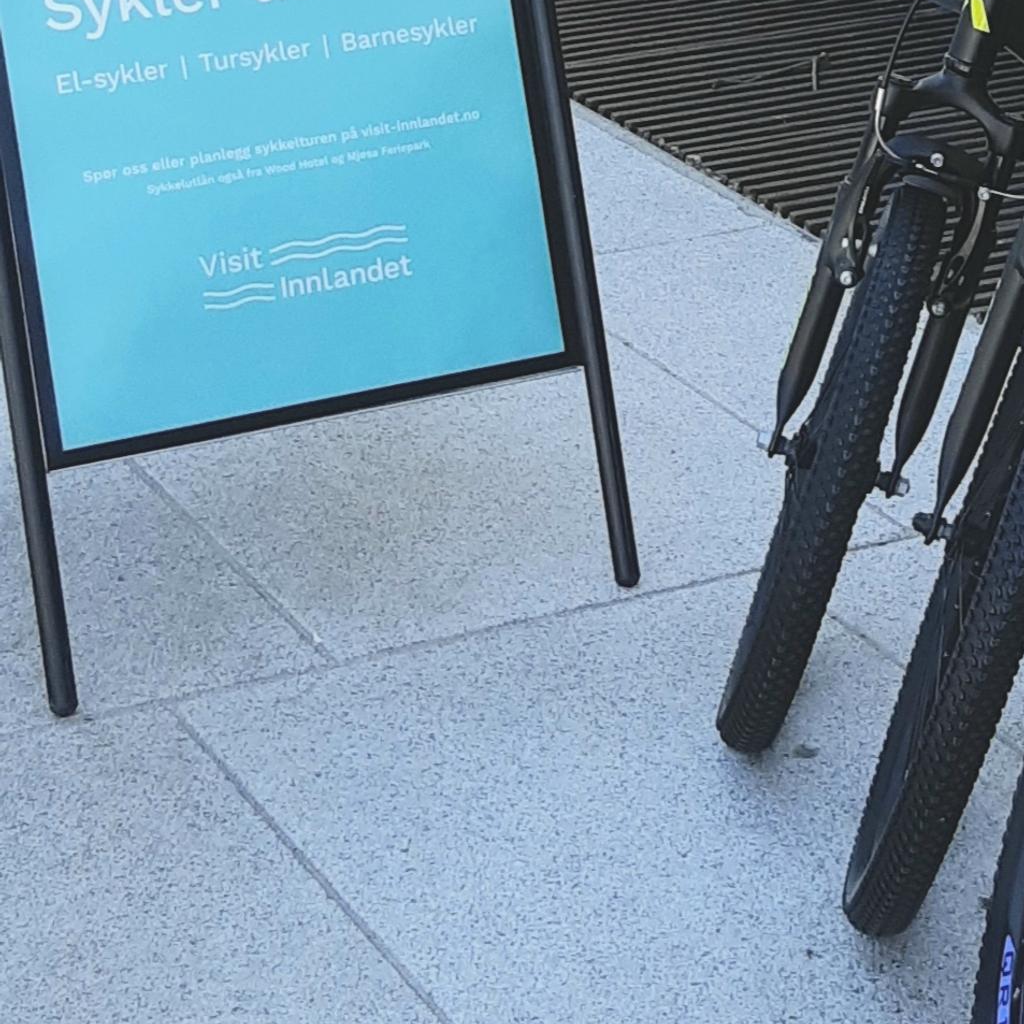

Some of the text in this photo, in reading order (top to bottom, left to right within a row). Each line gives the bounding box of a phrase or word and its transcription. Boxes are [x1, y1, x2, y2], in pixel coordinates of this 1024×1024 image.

[56, 61, 168, 94] El-sykler
[199, 41, 311, 72] Tursykler
[341, 16, 478, 52] Barnesykler
[82, 110, 480, 185] Spør oss eller planlegg sykkelturen på visit-innlandet.no
[147, 175, 216, 196] Sykkelutlån
[217, 168, 244, 185] også
[246, 167, 262, 178] fra
[264, 162, 296, 176] Wood
[299, 155, 329, 170] Hotel
[331, 151, 345, 166] og
[199, 246, 264, 278] Visit
[280, 255, 413, 299] Innlandet
